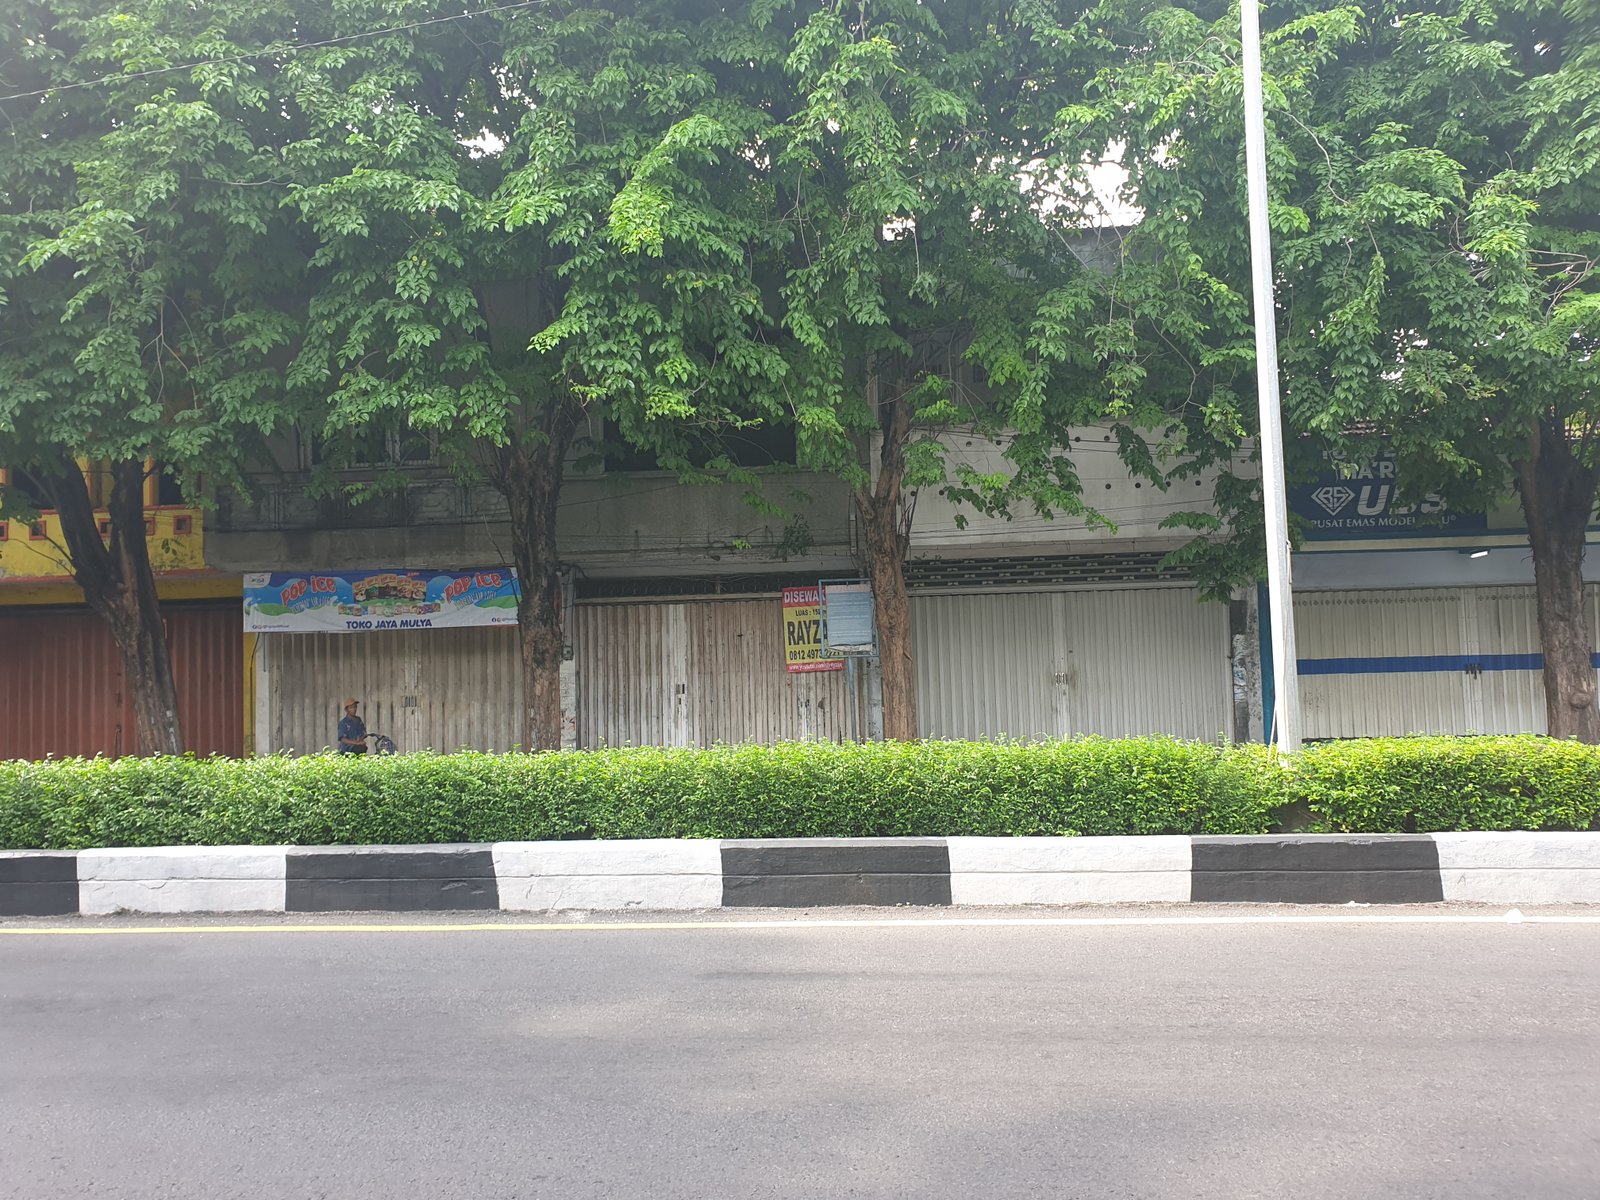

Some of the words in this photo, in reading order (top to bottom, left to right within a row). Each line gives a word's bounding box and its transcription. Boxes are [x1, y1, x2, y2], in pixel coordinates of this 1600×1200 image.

[1339, 462, 1397, 480] MA'R
[1311, 519, 1344, 528] PUSAT
[1346, 517, 1376, 527] EMAS
[281, 579, 307, 607] POP
[444, 576, 471, 604] POP
[346, 620, 372, 629] TOKO
[375, 619, 398, 629] JAYA
[399, 618, 432, 628] MULYA
[789, 650, 806, 660] 0812
